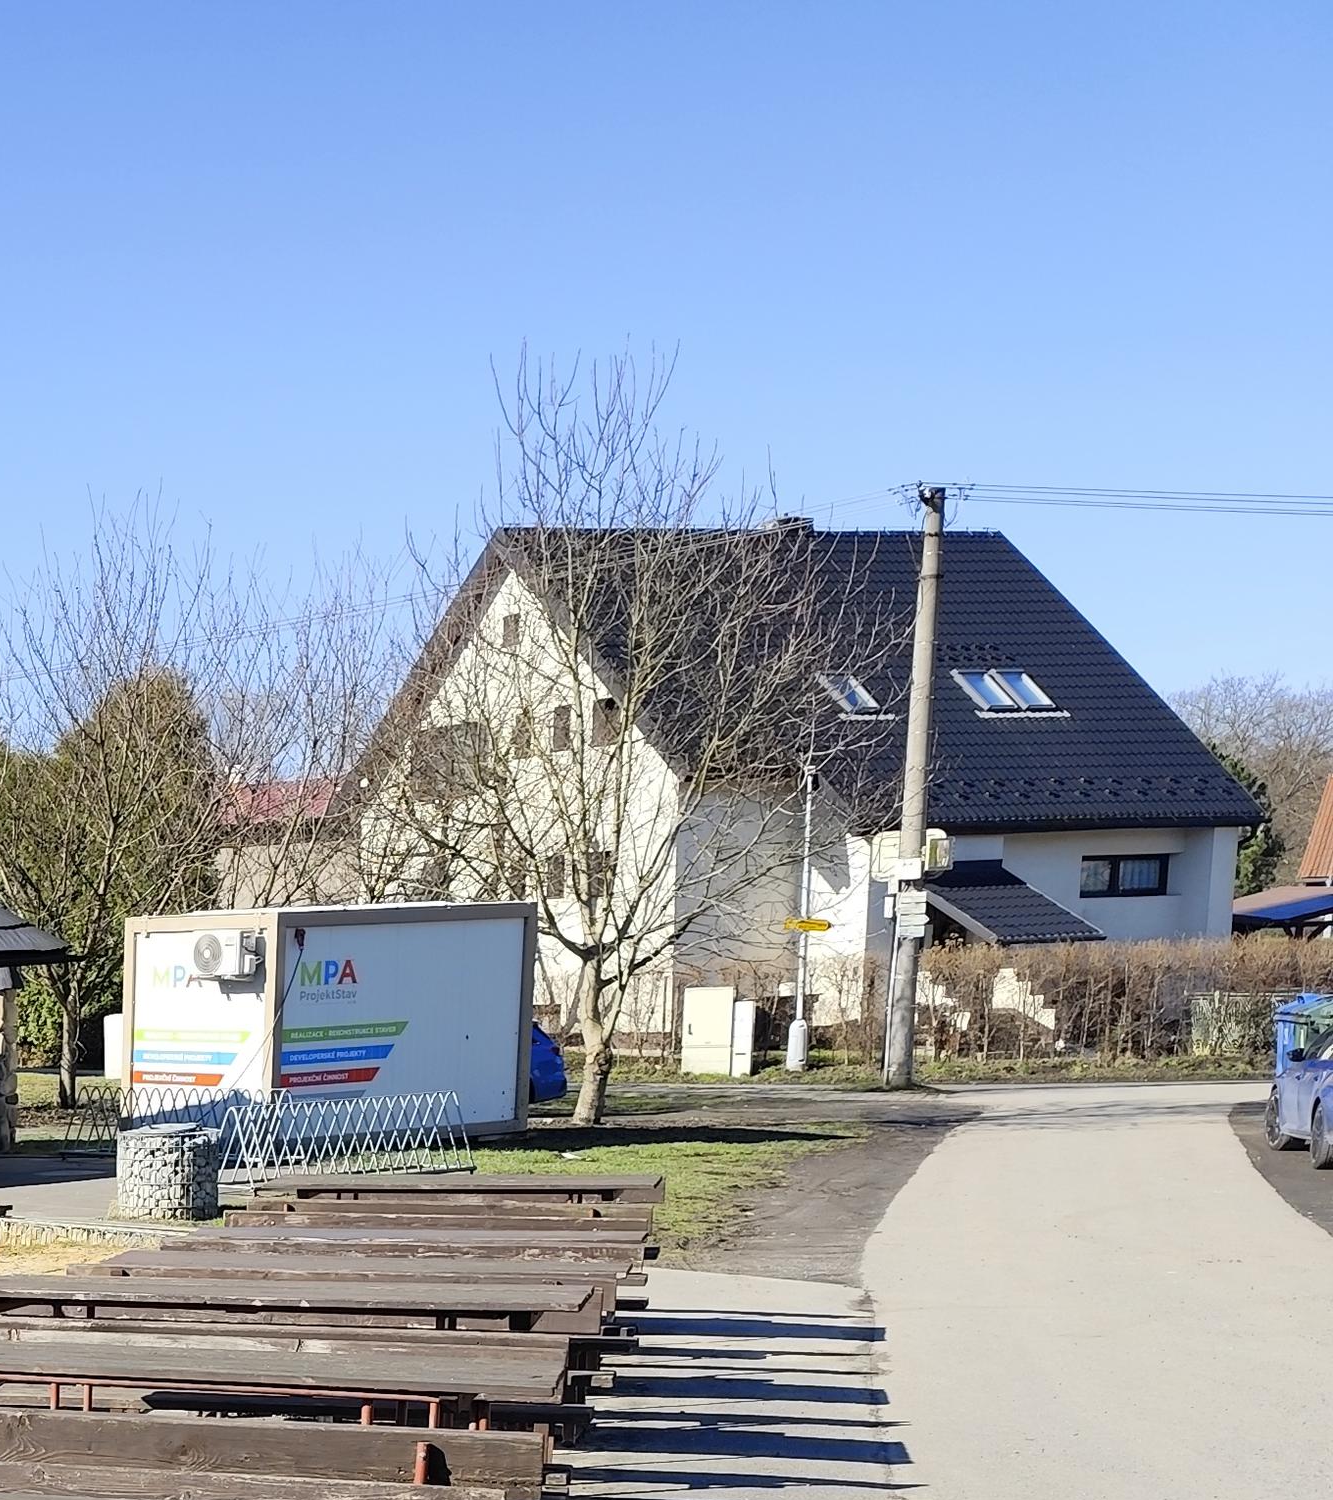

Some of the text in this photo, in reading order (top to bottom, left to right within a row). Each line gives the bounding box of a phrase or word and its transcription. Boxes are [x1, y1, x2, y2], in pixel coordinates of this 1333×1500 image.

[299, 958, 358, 988] MPA
[299, 988, 358, 1004] ProjektStav
[290, 1030, 324, 1040] REALIZACE
[289, 1049, 367, 1063] DEVELOPERSKÉ PROJEKTY
[288, 1072, 349, 1085] PROJEKČNÍ ČINNOST
